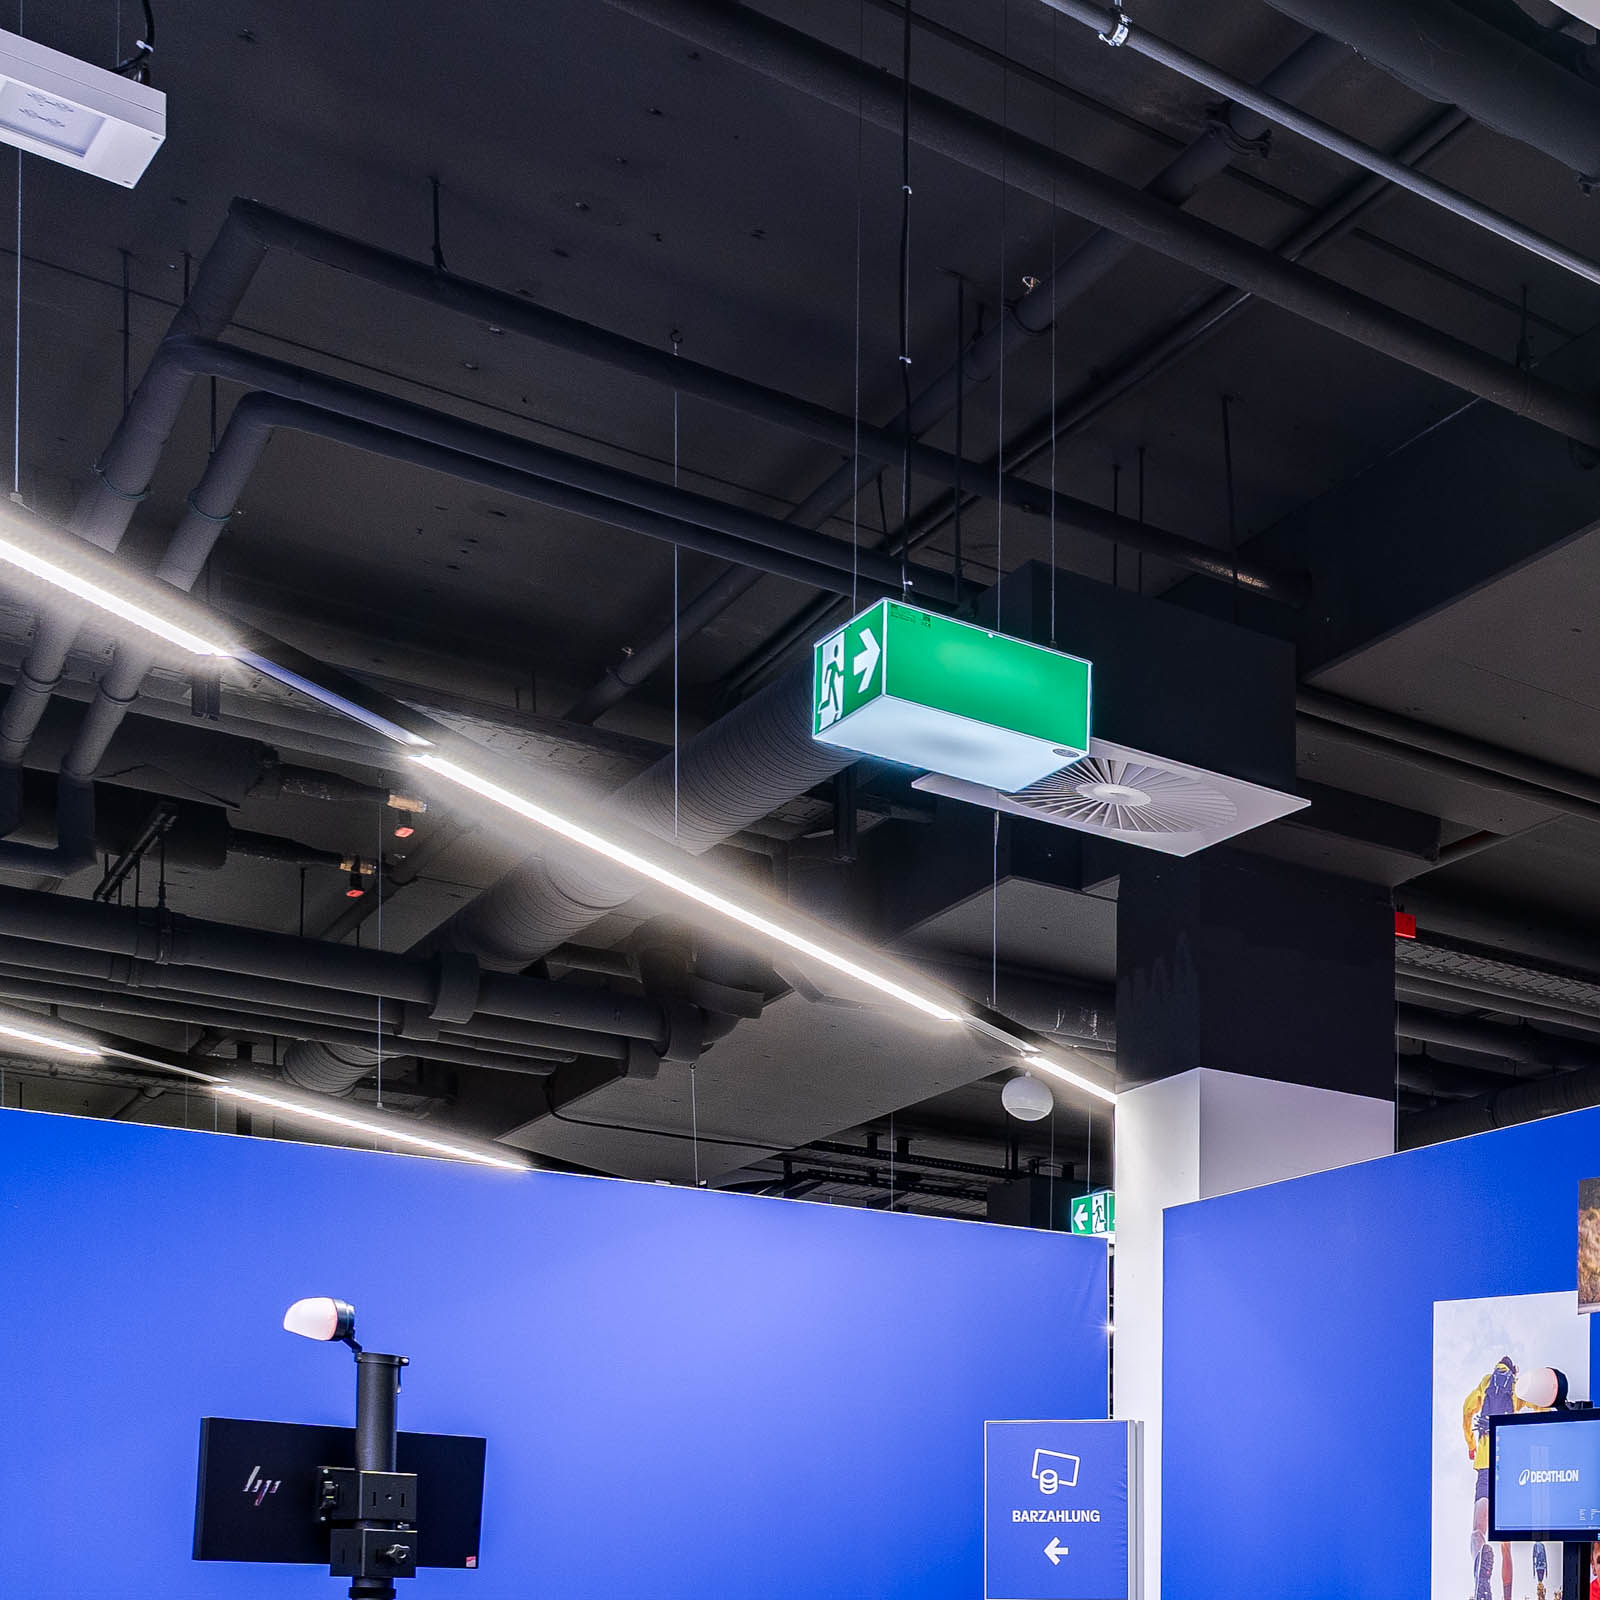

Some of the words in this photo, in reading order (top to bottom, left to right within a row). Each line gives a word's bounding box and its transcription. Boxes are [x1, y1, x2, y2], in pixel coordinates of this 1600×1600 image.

[1530, 1469, 1579, 1483] DECATHLON
[242, 1465, 282, 1506] hp
[1012, 1509, 1101, 1524] BARZAHLUNG
